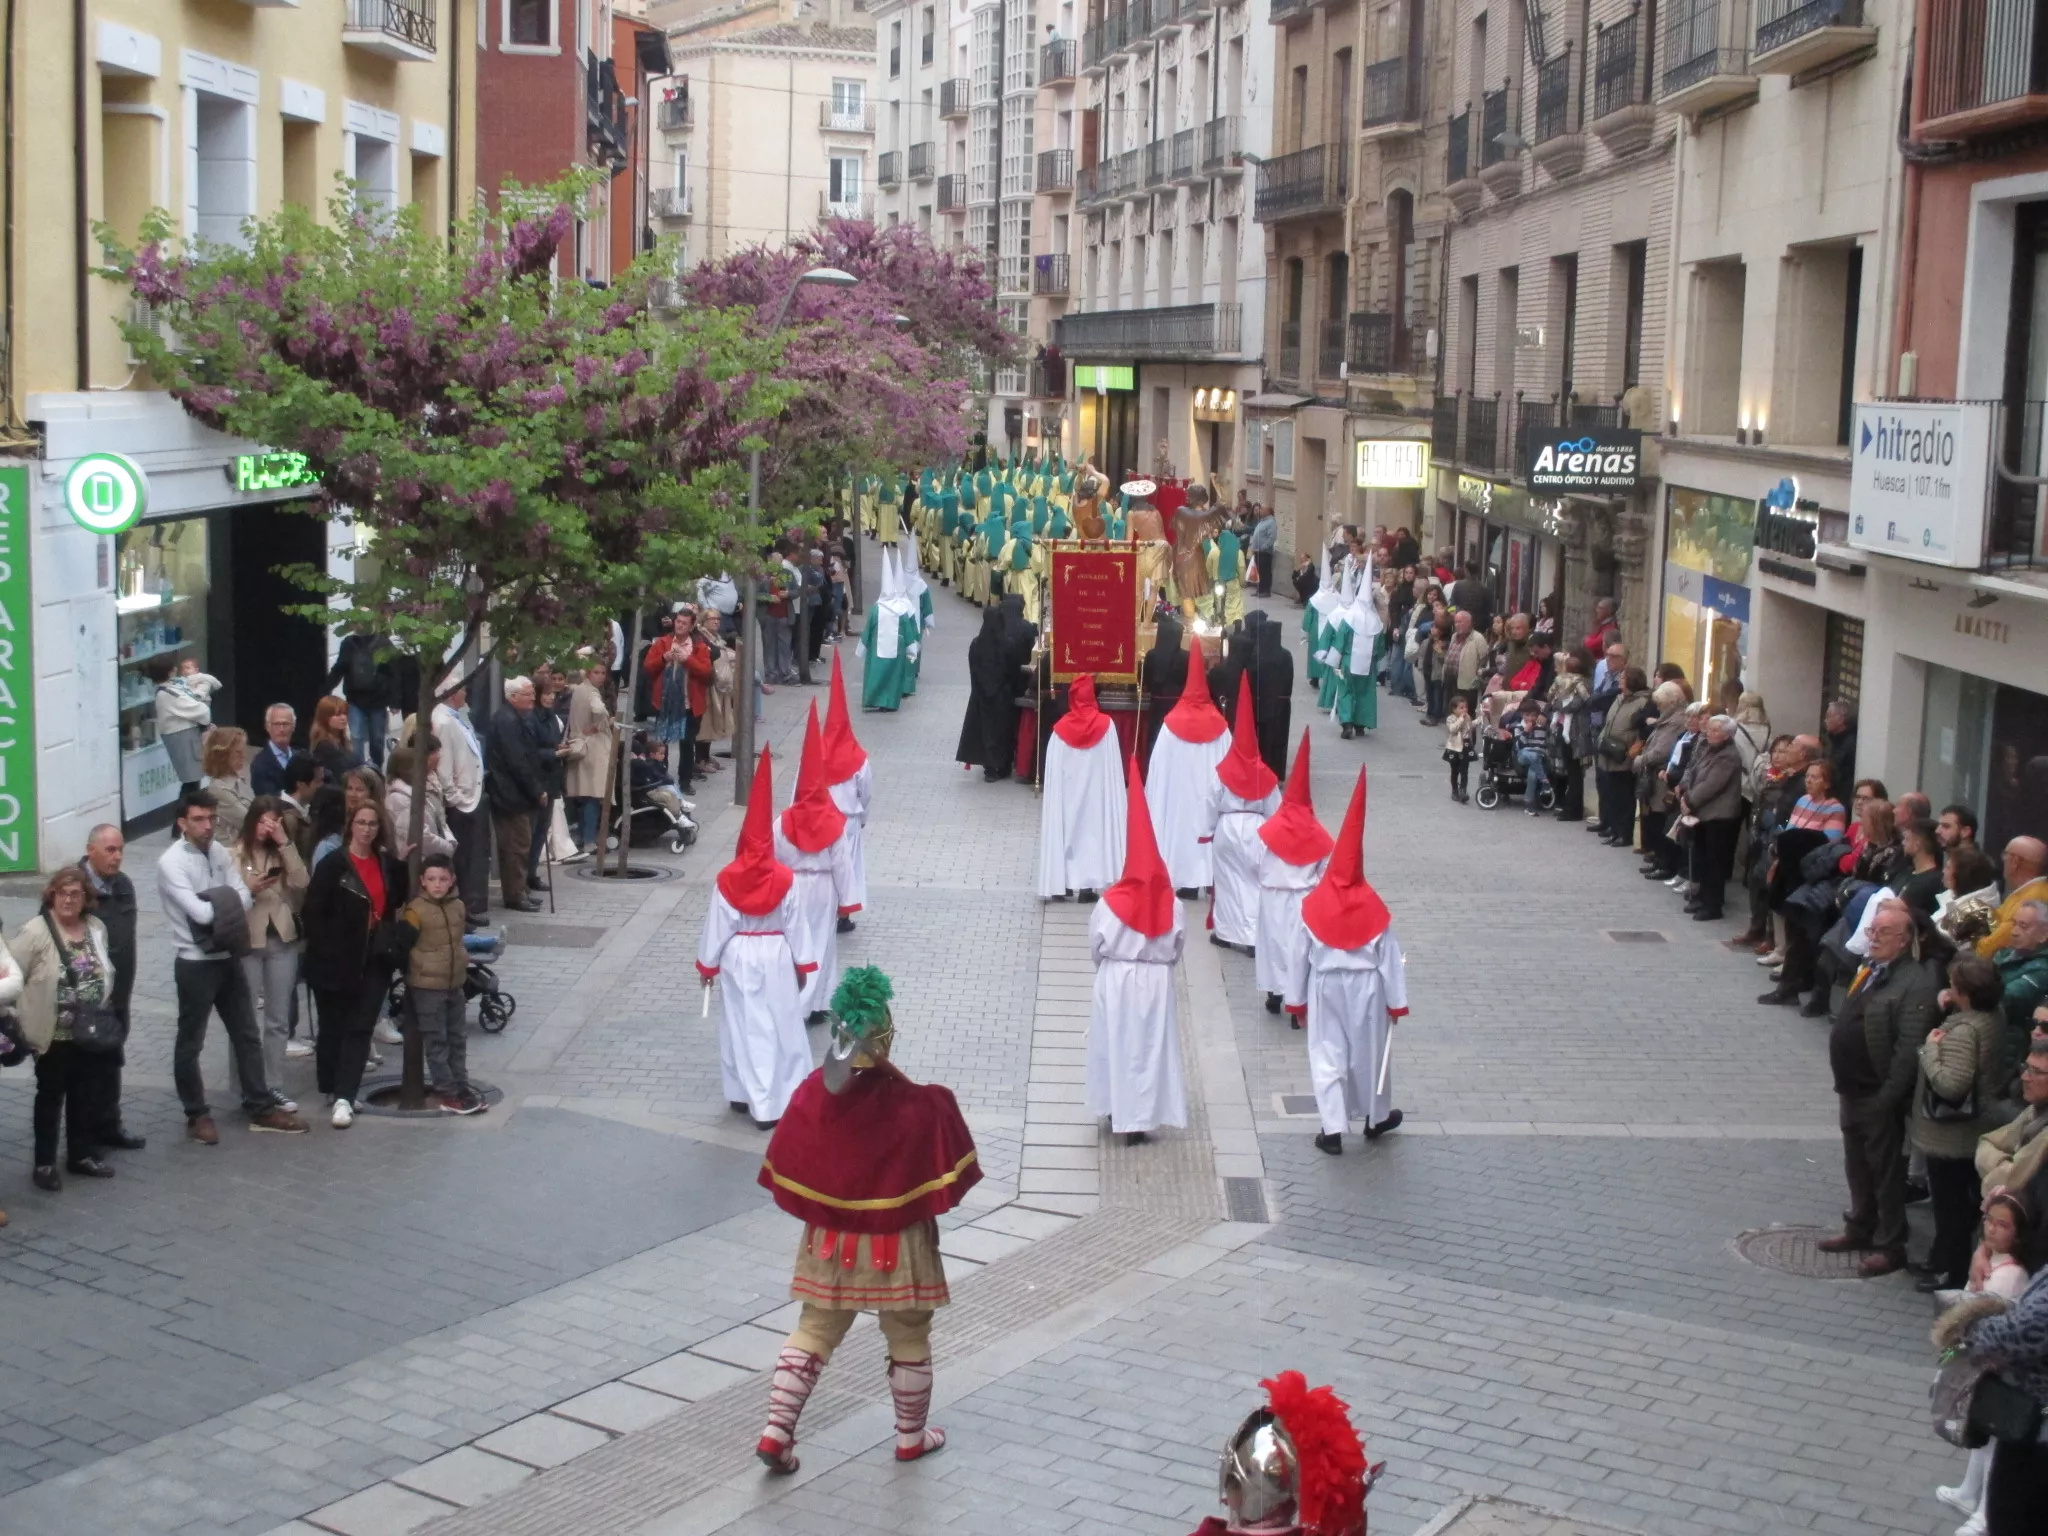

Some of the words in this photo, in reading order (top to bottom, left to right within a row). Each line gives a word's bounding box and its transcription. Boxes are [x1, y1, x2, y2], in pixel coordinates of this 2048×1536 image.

[1876, 416, 1953, 467] hitradio
[1533, 445, 1636, 474] Arenas
[1533, 474, 1562, 484] CENTRO
[1564, 473, 1592, 485] ÓPTICO
[1593, 476, 1600, 485] Y
[1600, 477, 1635, 486] AUDITIVO
[1873, 469, 1906, 493] Huesca
